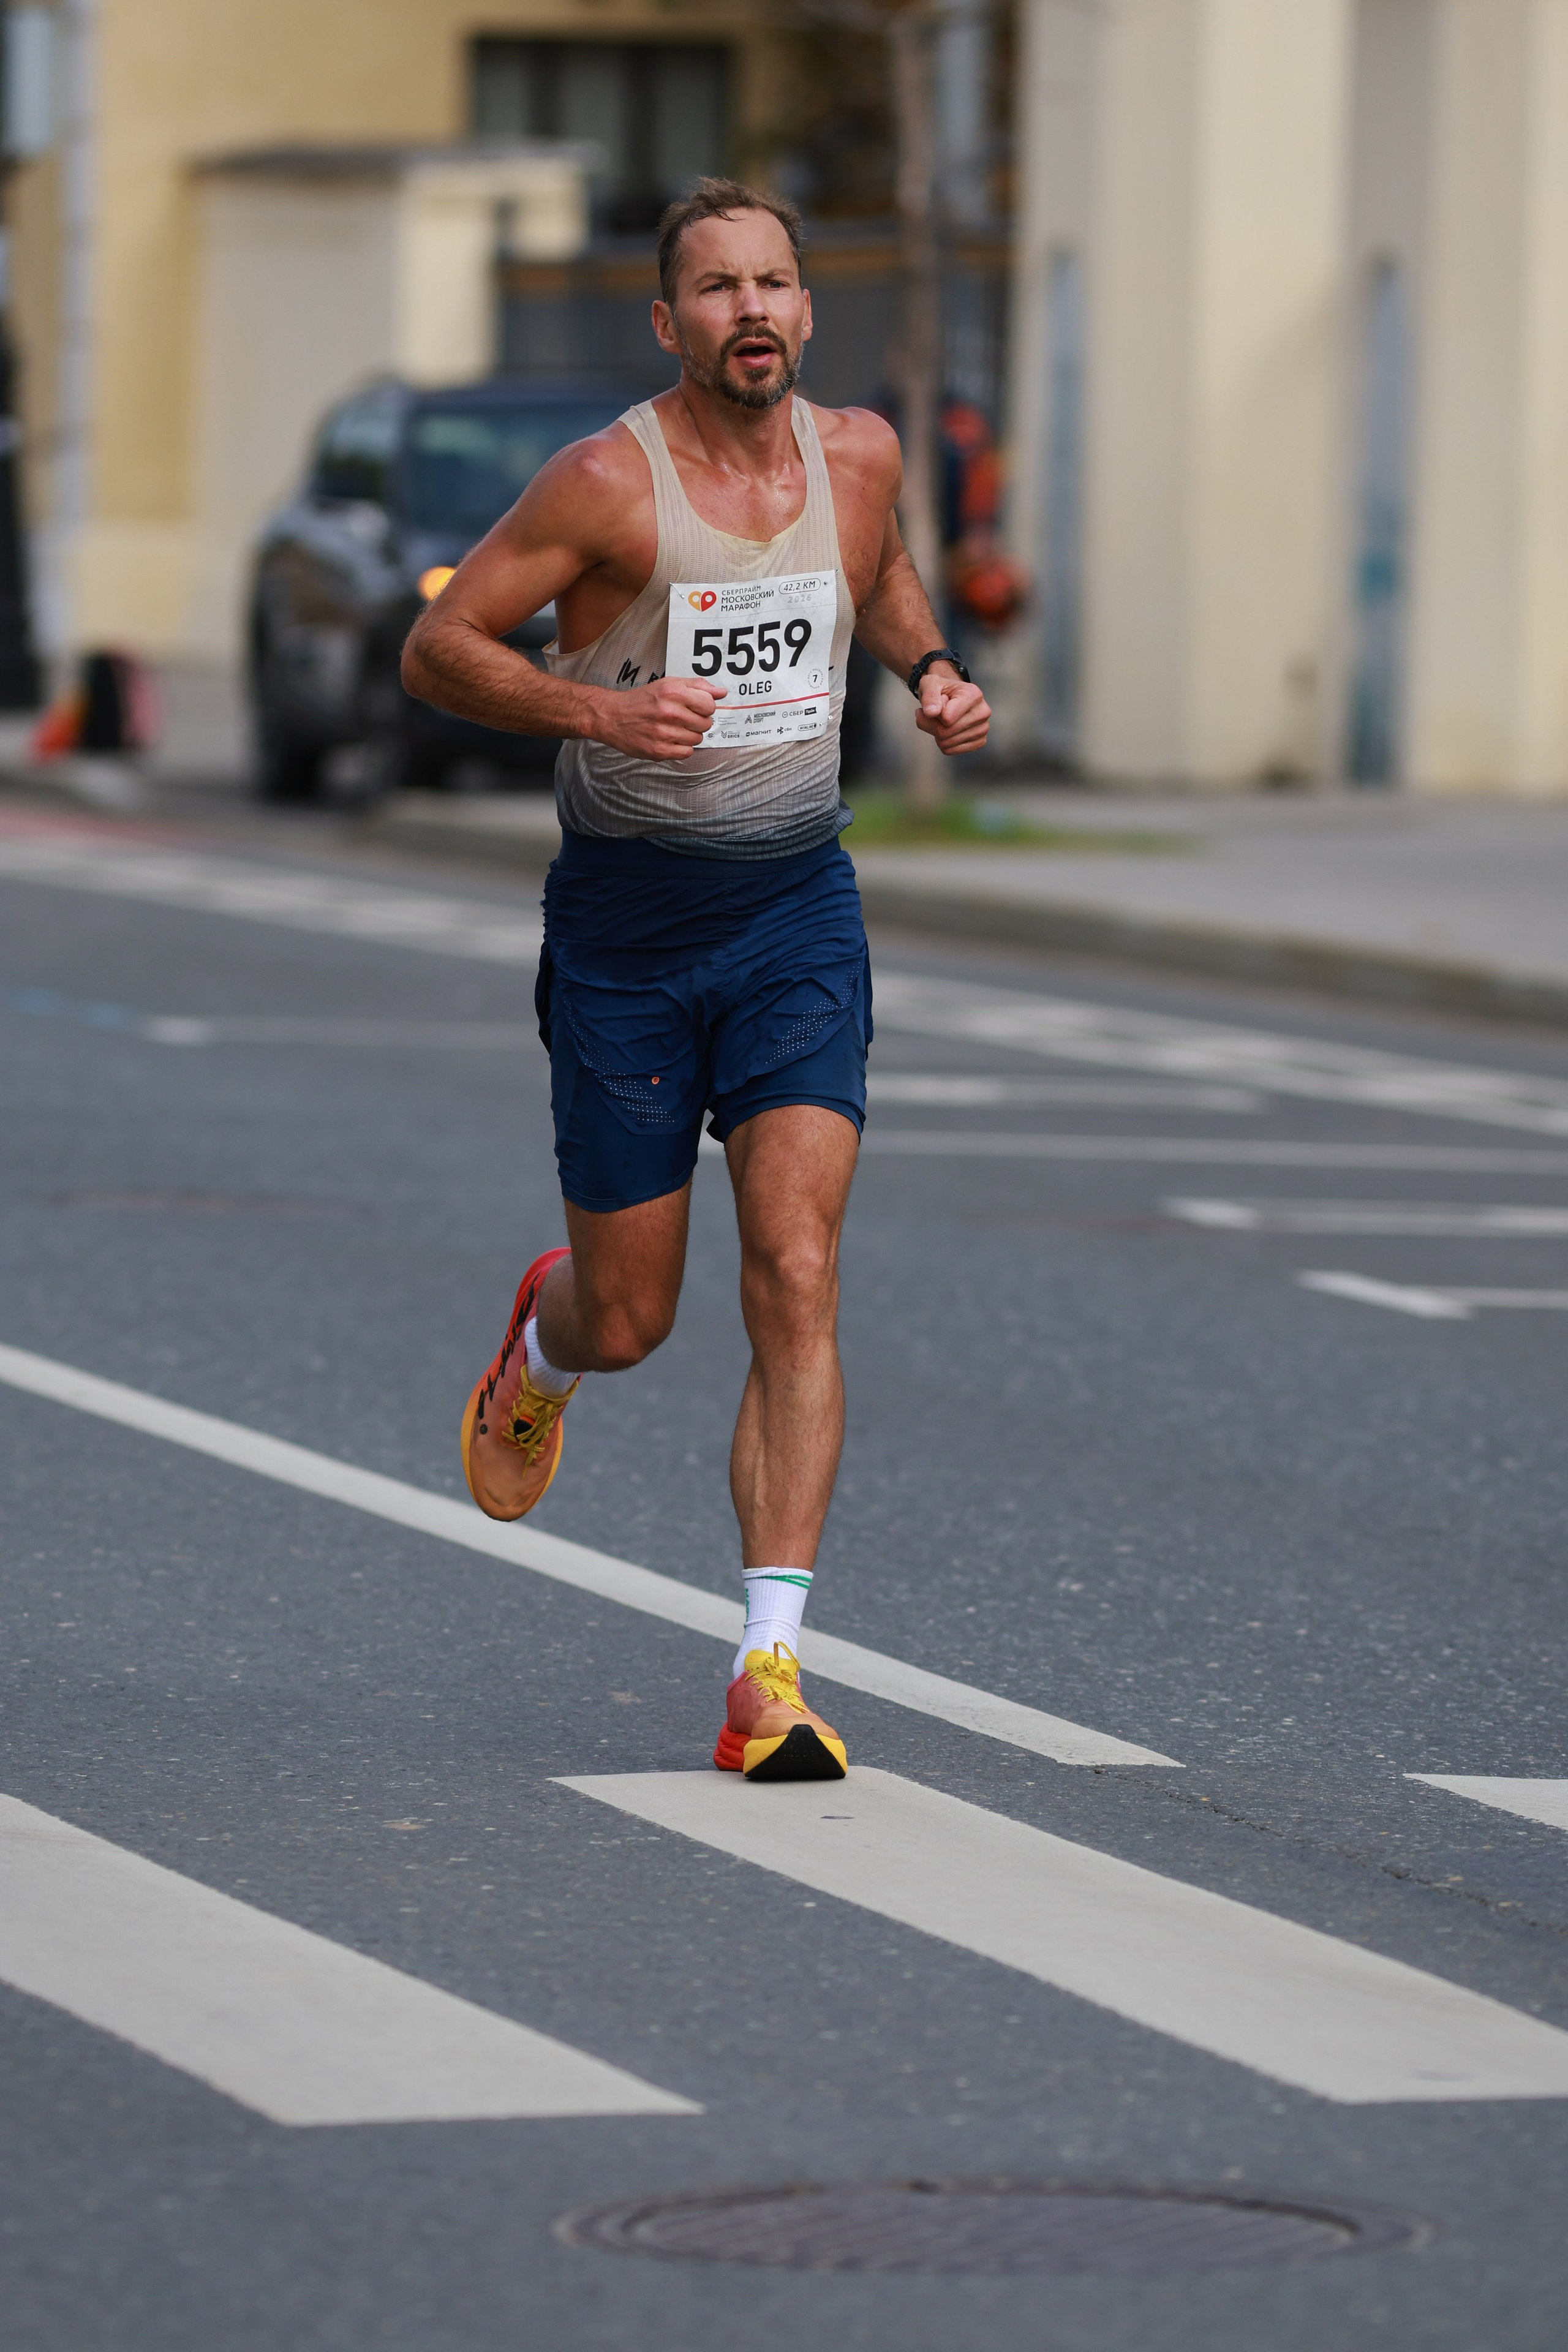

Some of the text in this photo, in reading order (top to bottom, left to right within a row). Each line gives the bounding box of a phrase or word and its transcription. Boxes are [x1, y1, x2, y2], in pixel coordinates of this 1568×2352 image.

[722, 586, 761, 596] СБЕРПРАЙМ
[783, 582, 800, 592] 42,2
[721, 589, 774, 604] МОСКОВСКИЙ
[787, 594, 812, 603] 2026
[721, 601, 761, 612] МАРАФОН
[692, 619, 812, 677] 5559
[739, 680, 772, 696] OLEG
